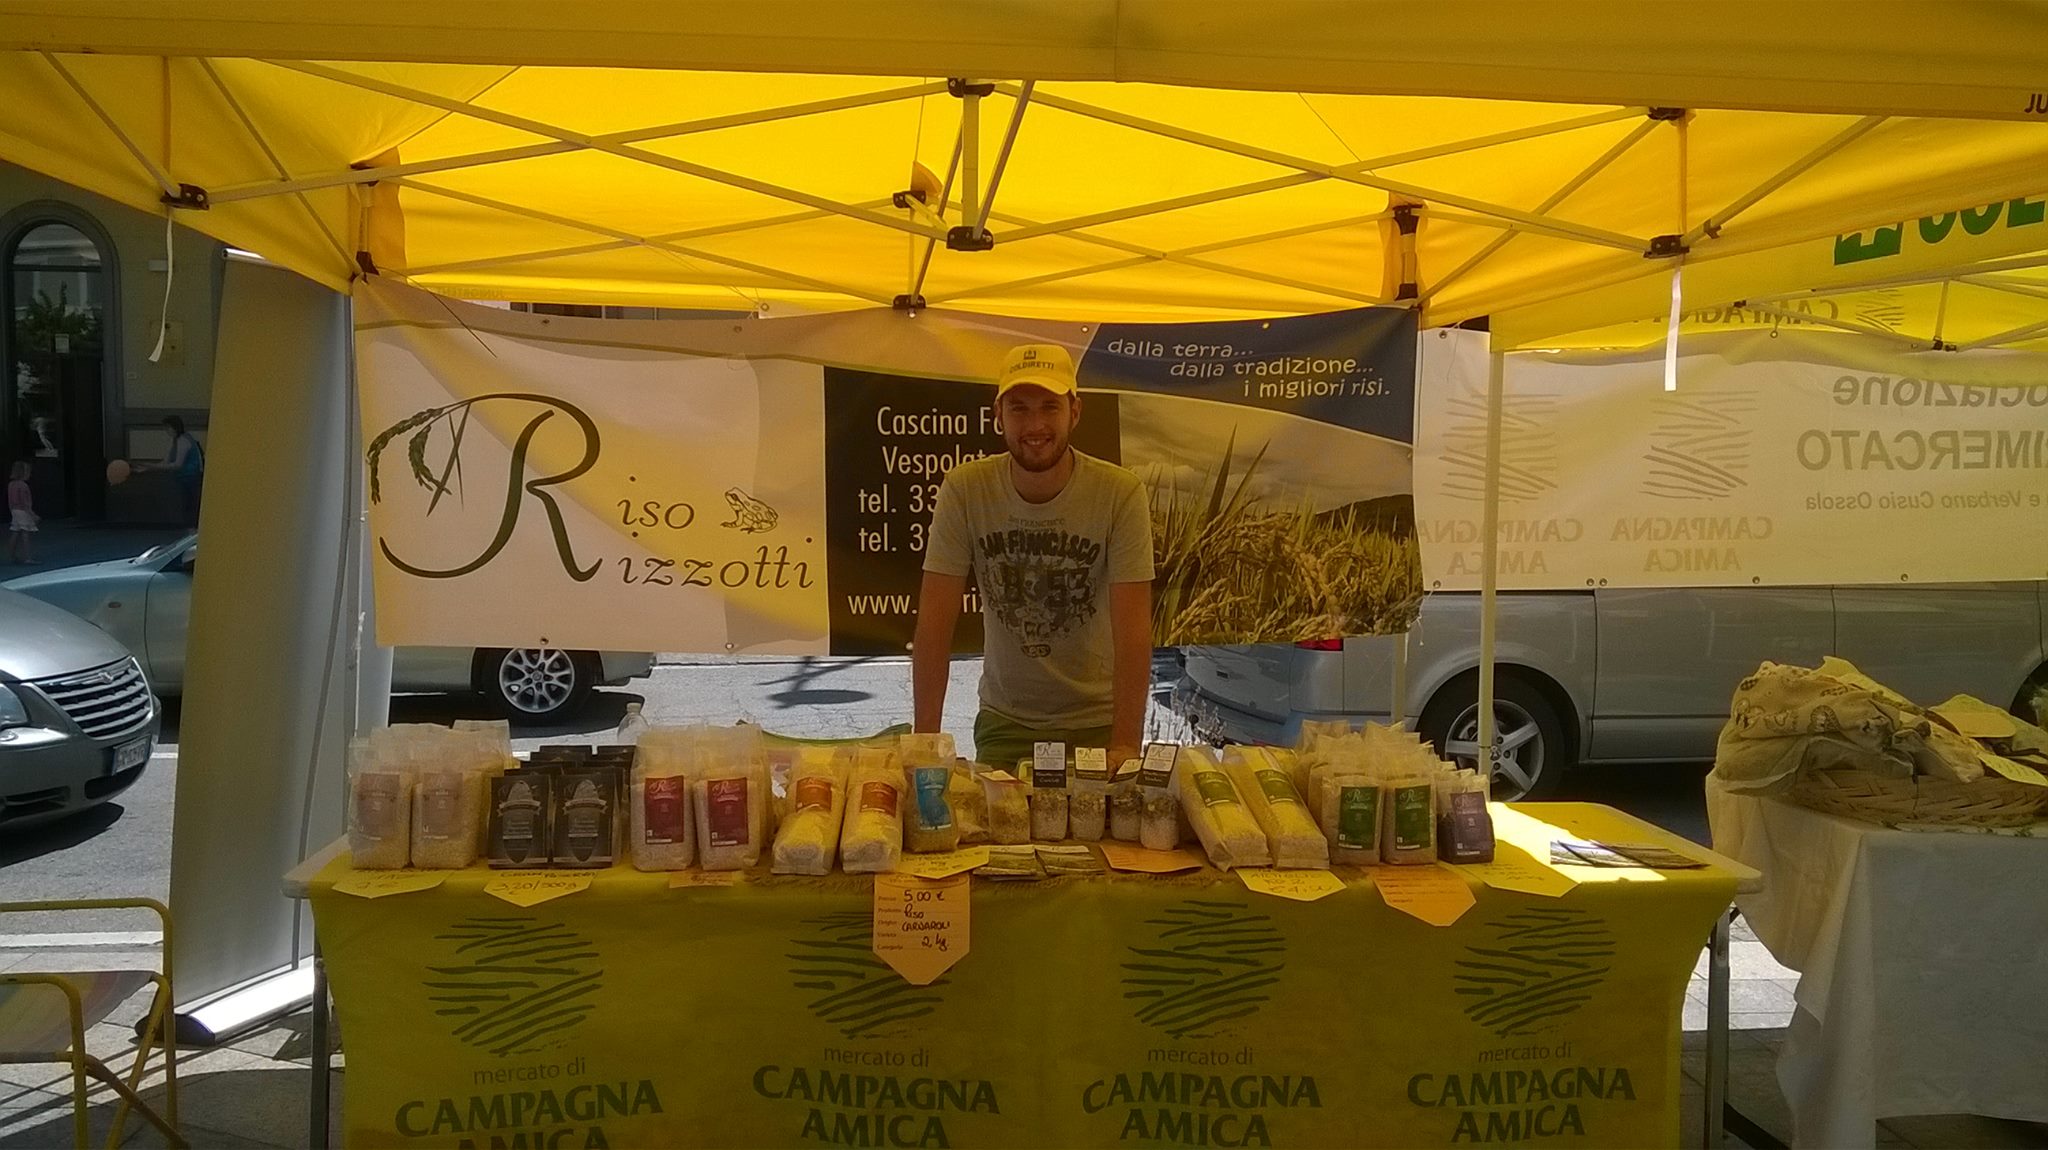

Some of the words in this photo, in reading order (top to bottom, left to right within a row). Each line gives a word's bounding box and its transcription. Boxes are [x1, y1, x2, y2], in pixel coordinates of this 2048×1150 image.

[1107, 338, 1164, 358] dalla
[1172, 343, 1253, 358] terra...
[1170, 361, 1225, 378] dalla
[1233, 357, 1374, 376] tradizione...
[1244, 379, 1250, 397] i
[1259, 378, 1345, 400] migliori
[1351, 378, 1390, 396] risi.
[877, 406, 968, 436] Cascina
[858, 483, 897, 513] tel.
[910, 484, 940, 513] 33
[858, 522, 897, 552] tel.
[824, 1048, 905, 1067] mercato
[911, 1048, 929, 1068] di
[1148, 1048, 1229, 1066] mercato
[1235, 1047, 1253, 1065] di
[1478, 1046, 1549, 1063] mercato
[1555, 1042, 1572, 1059] di
[474, 1062, 560, 1085] mercato
[567, 1057, 586, 1076] di
[752, 1064, 1000, 1115] CAMPAGNA
[1082, 1071, 1323, 1114] CAMPAGNA
[1407, 1066, 1637, 1108] CAMPAGNA
[394, 1078, 664, 1138] CAMPAGNA
[1451, 1103, 1586, 1143] AMICA
[801, 1107, 951, 1150] AMICA
[1119, 1108, 1272, 1148] AMICA
